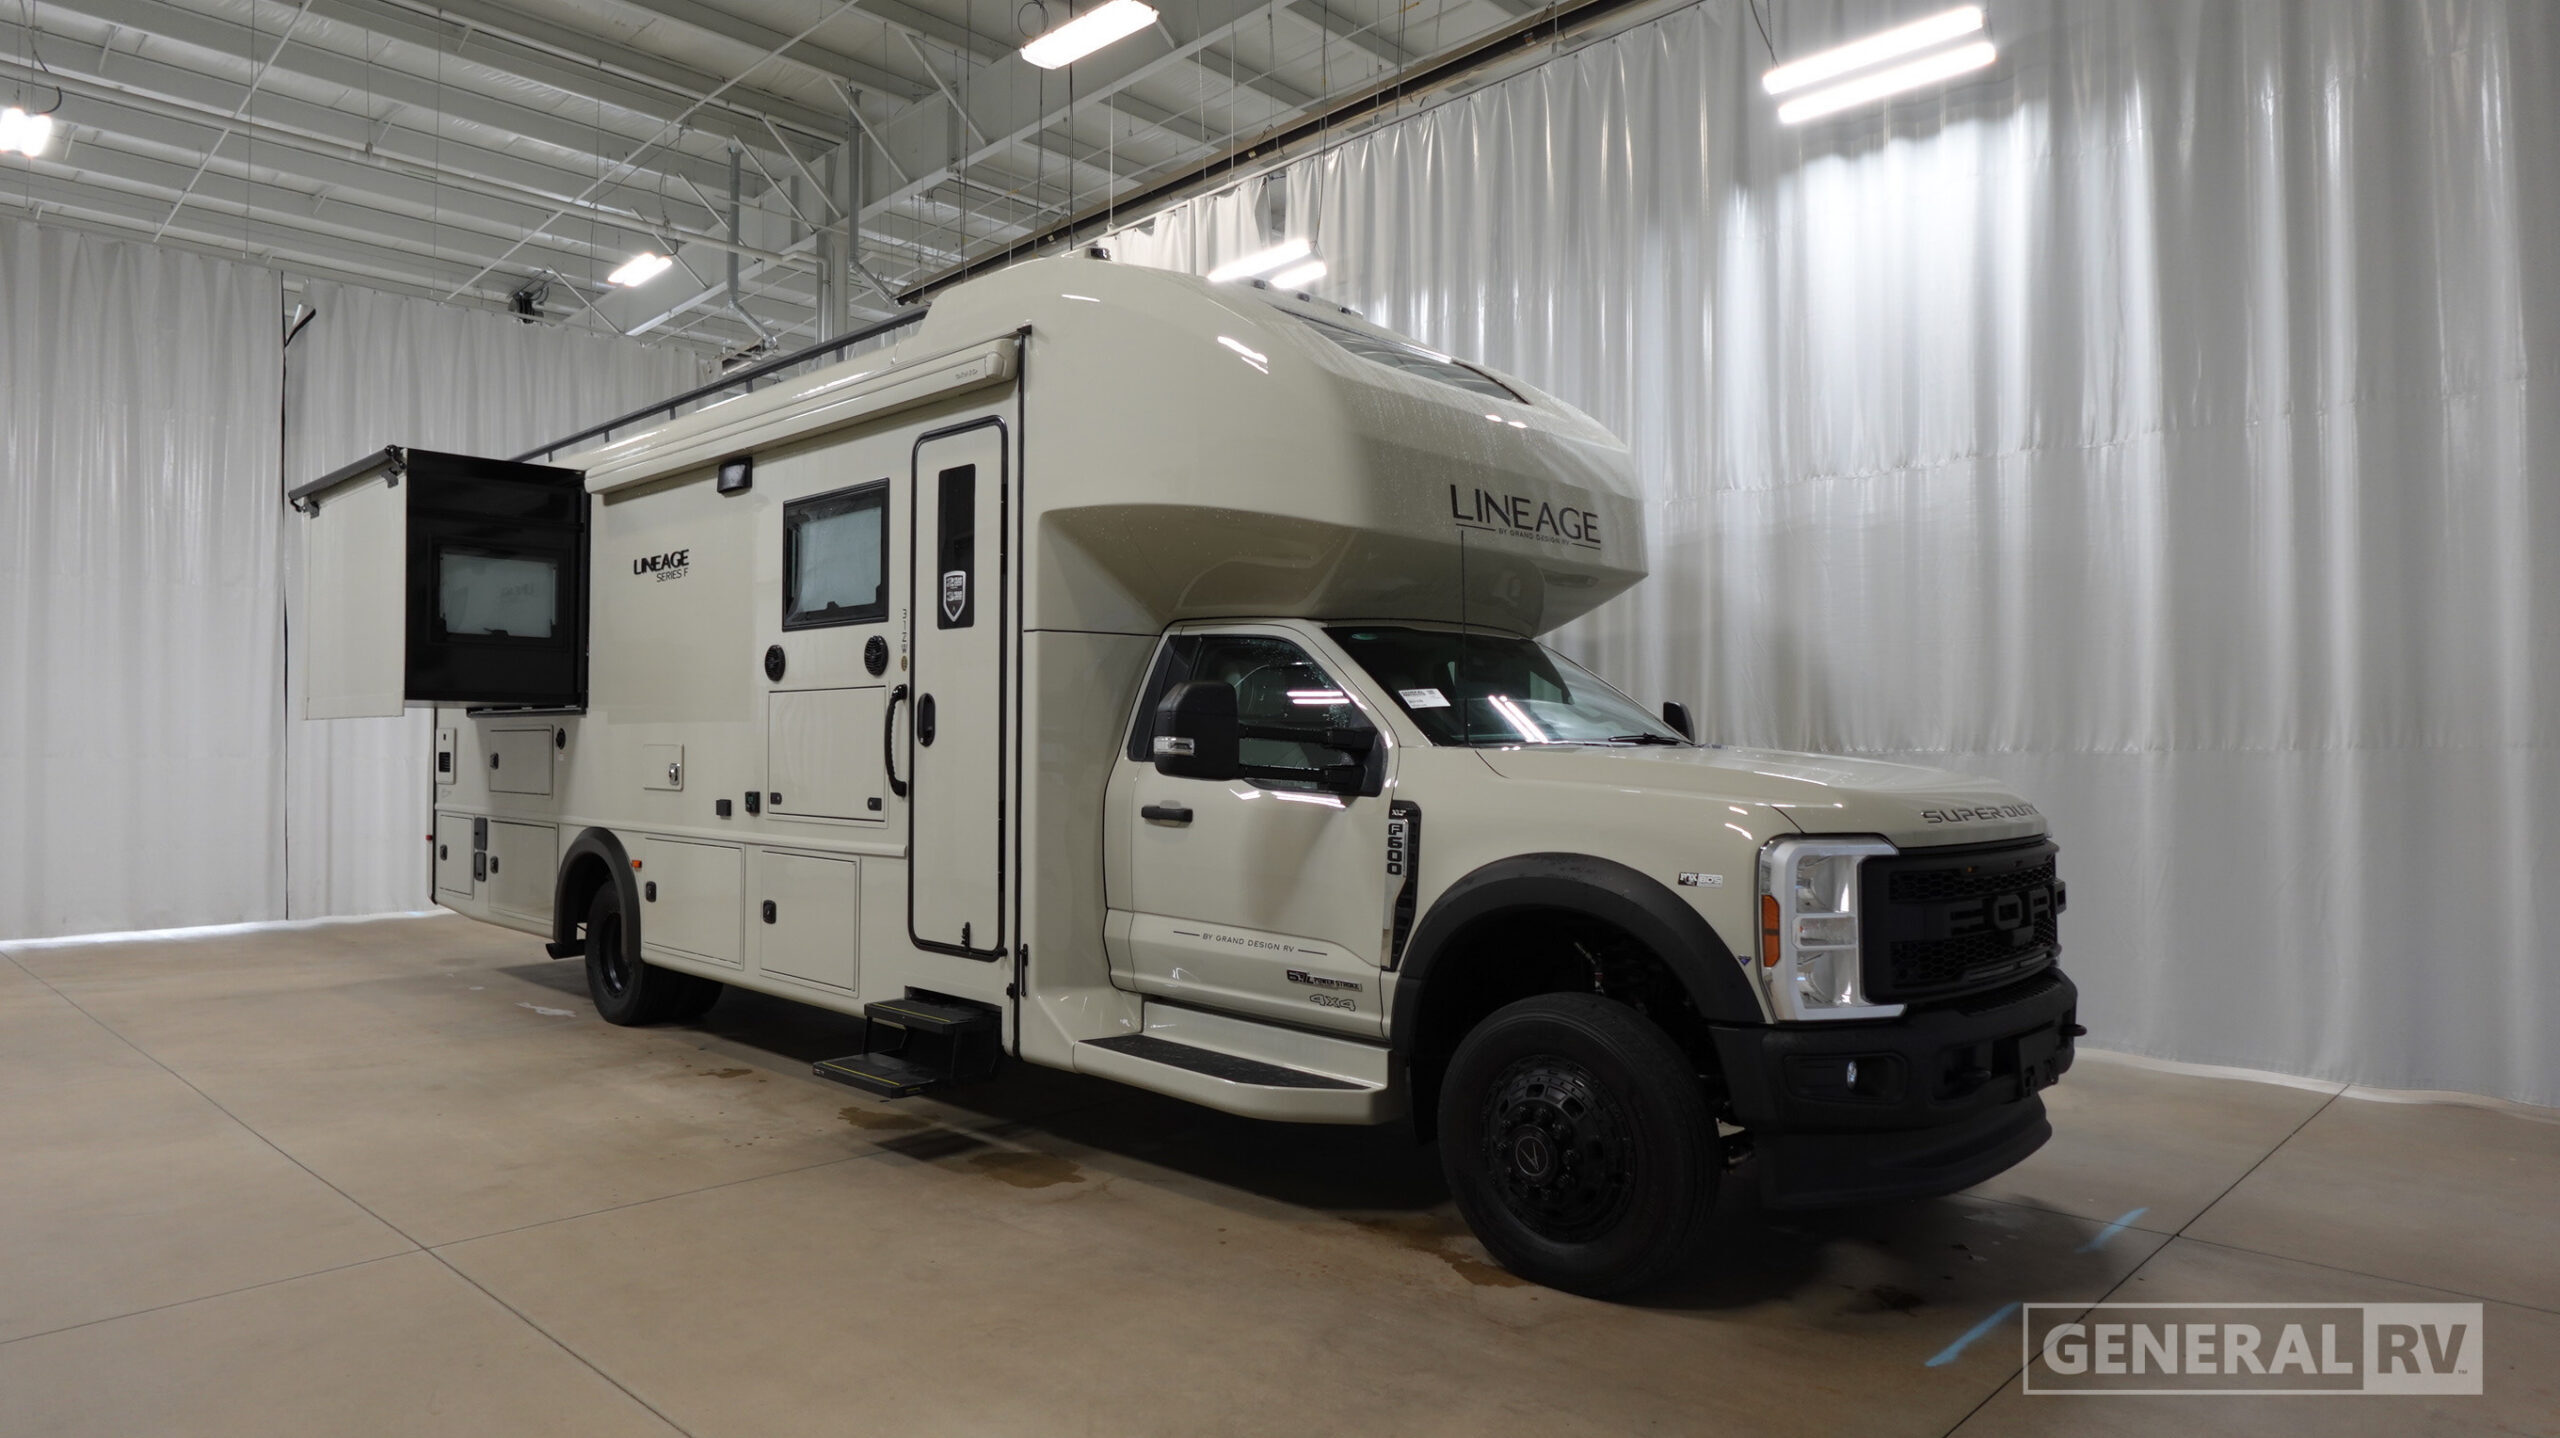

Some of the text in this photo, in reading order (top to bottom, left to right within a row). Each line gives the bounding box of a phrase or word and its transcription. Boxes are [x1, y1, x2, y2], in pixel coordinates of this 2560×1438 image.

[1450, 484, 1601, 544] LINEAGE
[1509, 530, 1534, 540] GRAND
[633, 549, 689, 575] LINEAGE
[656, 567, 689, 583] SERIES F
[1391, 809, 1407, 817] XLT
[1921, 803, 2040, 824] SUPER DUTY
[1386, 823, 1404, 876] F600
[1215, 935, 1245, 945] GRAND
[1247, 939, 1280, 951] DESIGN
[1283, 944, 1294, 952] RV
